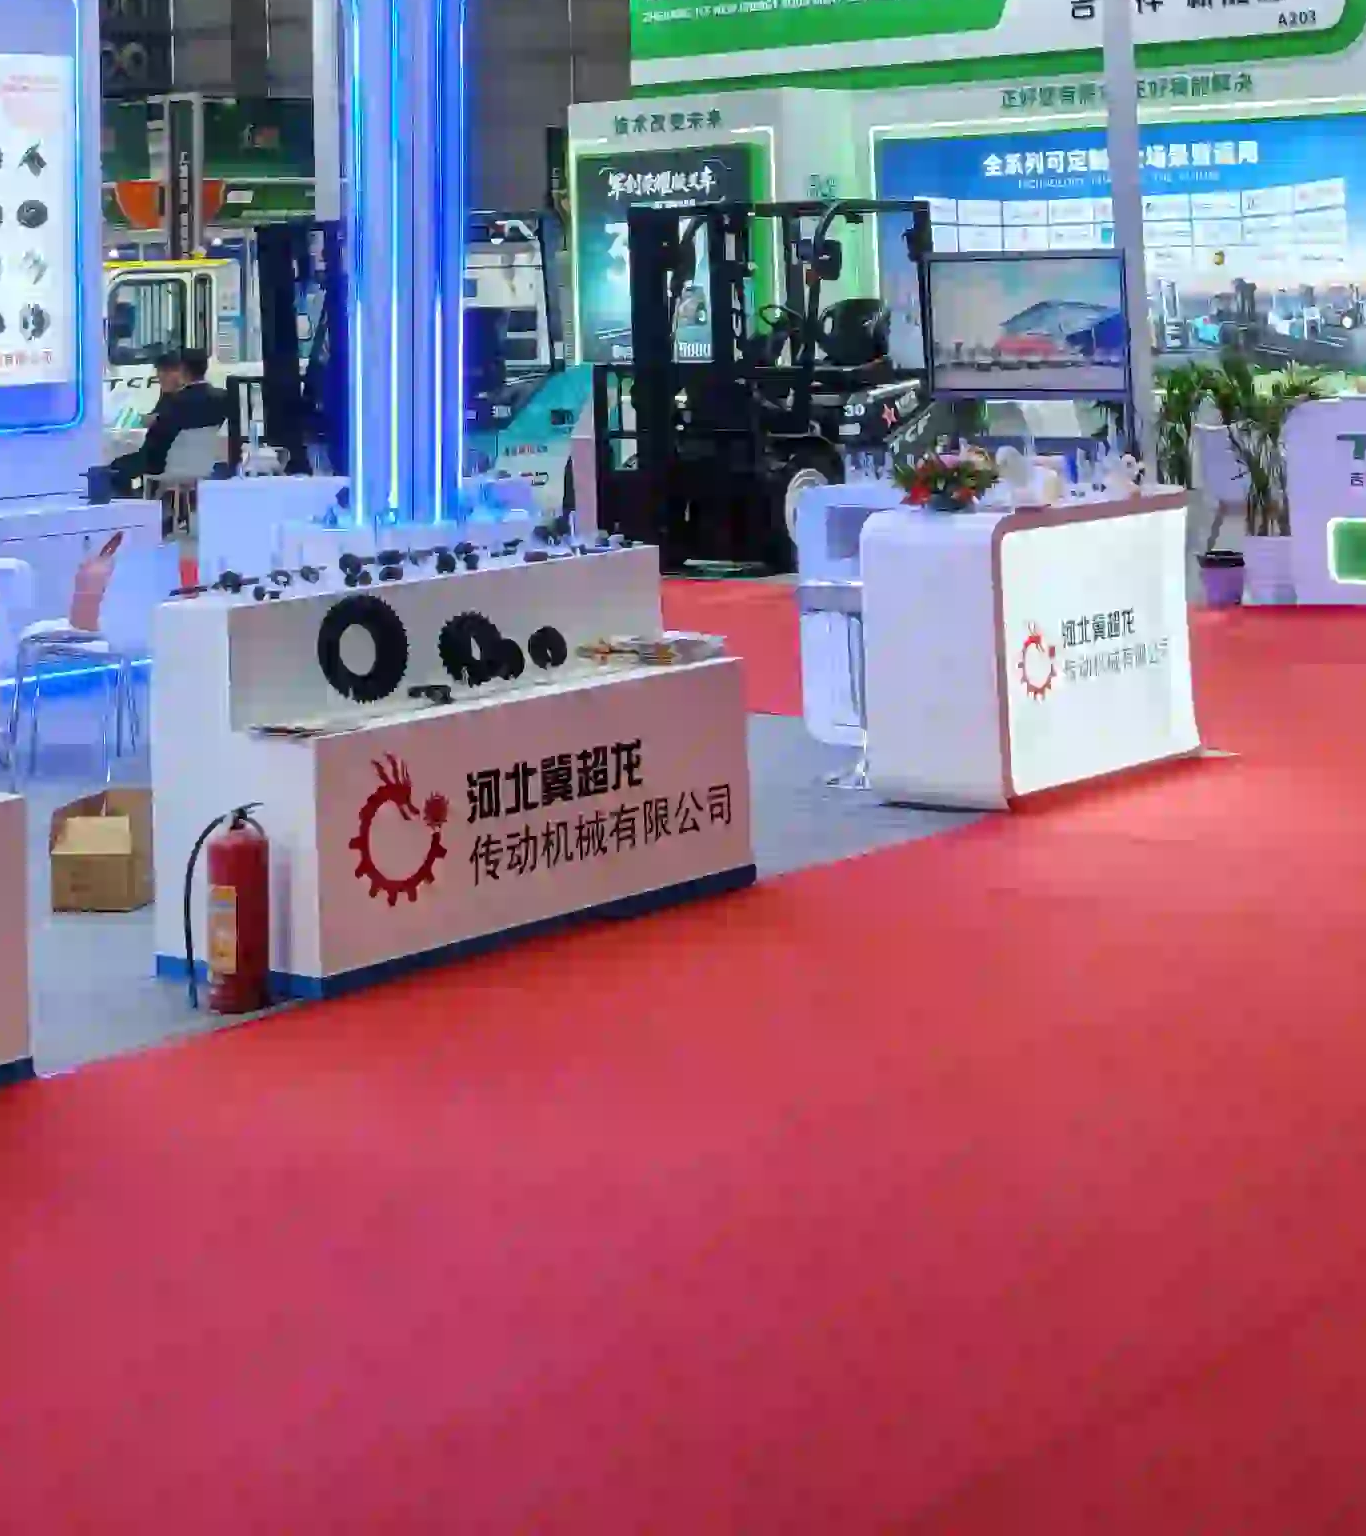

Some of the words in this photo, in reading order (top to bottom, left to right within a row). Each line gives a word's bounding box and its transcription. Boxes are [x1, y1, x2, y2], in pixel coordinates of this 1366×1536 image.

[842, 403, 866, 417] 30
[465, 738, 643, 824] 河北冀超龙
[469, 782, 733, 887] 传动机械有限公司
